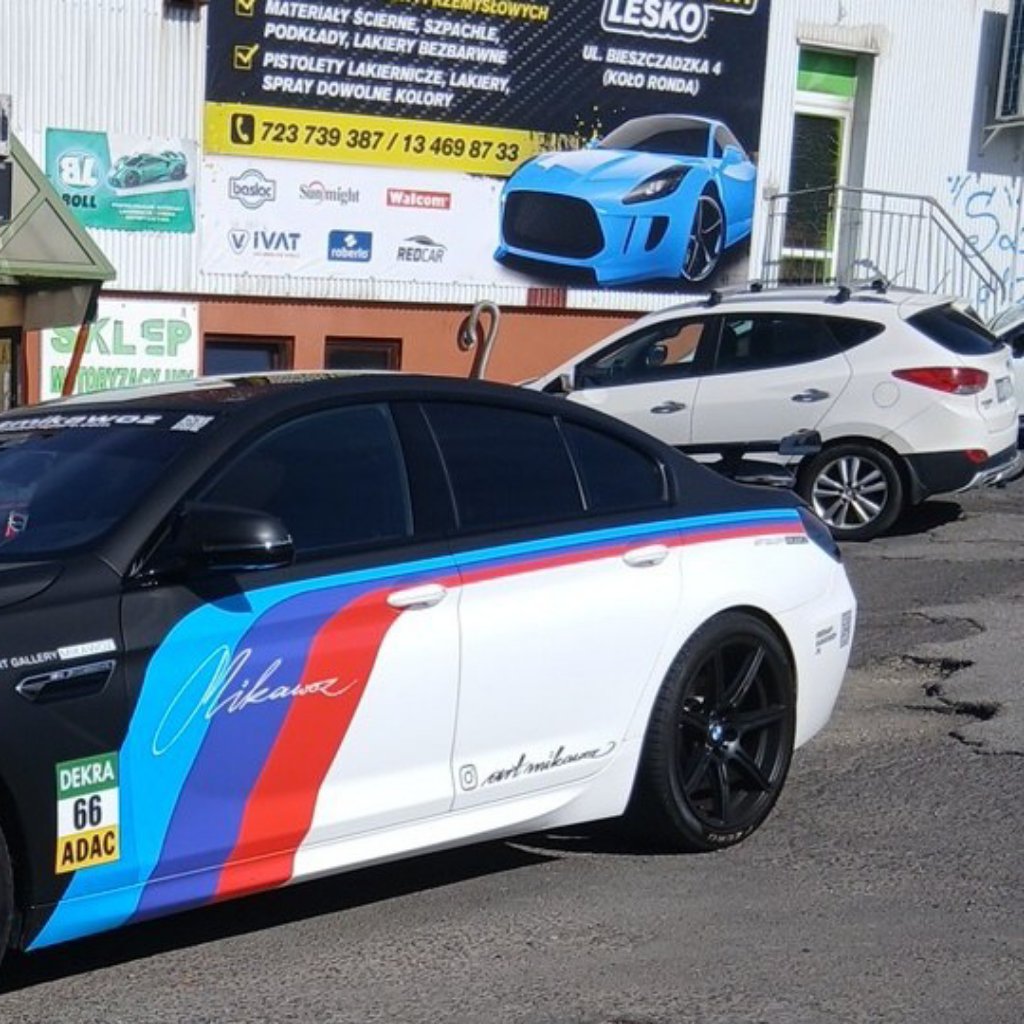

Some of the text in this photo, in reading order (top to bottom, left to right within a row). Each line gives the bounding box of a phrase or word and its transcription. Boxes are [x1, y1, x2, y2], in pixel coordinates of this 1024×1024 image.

[265, 0, 501, 44] MATERIAŁY ŚCIERNE, SZPACHLE,
[608, 0, 702, 33] LESKO
[264, 23, 509, 65] PODKŁADY, LAKIERY BEZBARWNE
[581, 45, 722, 76] UL. BIESZCZADZKA 4
[262, 52, 511, 95] PISTOLETY LAKIERNICZE, LAKIERY,
[262, 75, 454, 107] SPRAY DOWOLNE KOLORY
[647, 74, 700, 96] RONDA)
[262, 122, 298, 143] 723
[305, 125, 340, 146] 739
[346, 129, 383, 149] 387
[403, 135, 425, 153] 13
[430, 137, 464, 156] 469
[468, 140, 493, 159] 87
[495, 143, 519, 161] 33
[51, 317, 192, 357] SKLEP
[10, 651, 58, 668] GALLERY
[60, 760, 115, 791] DEKRA
[73, 794, 102, 831] 66
[62, 830, 115, 866] ADAC
